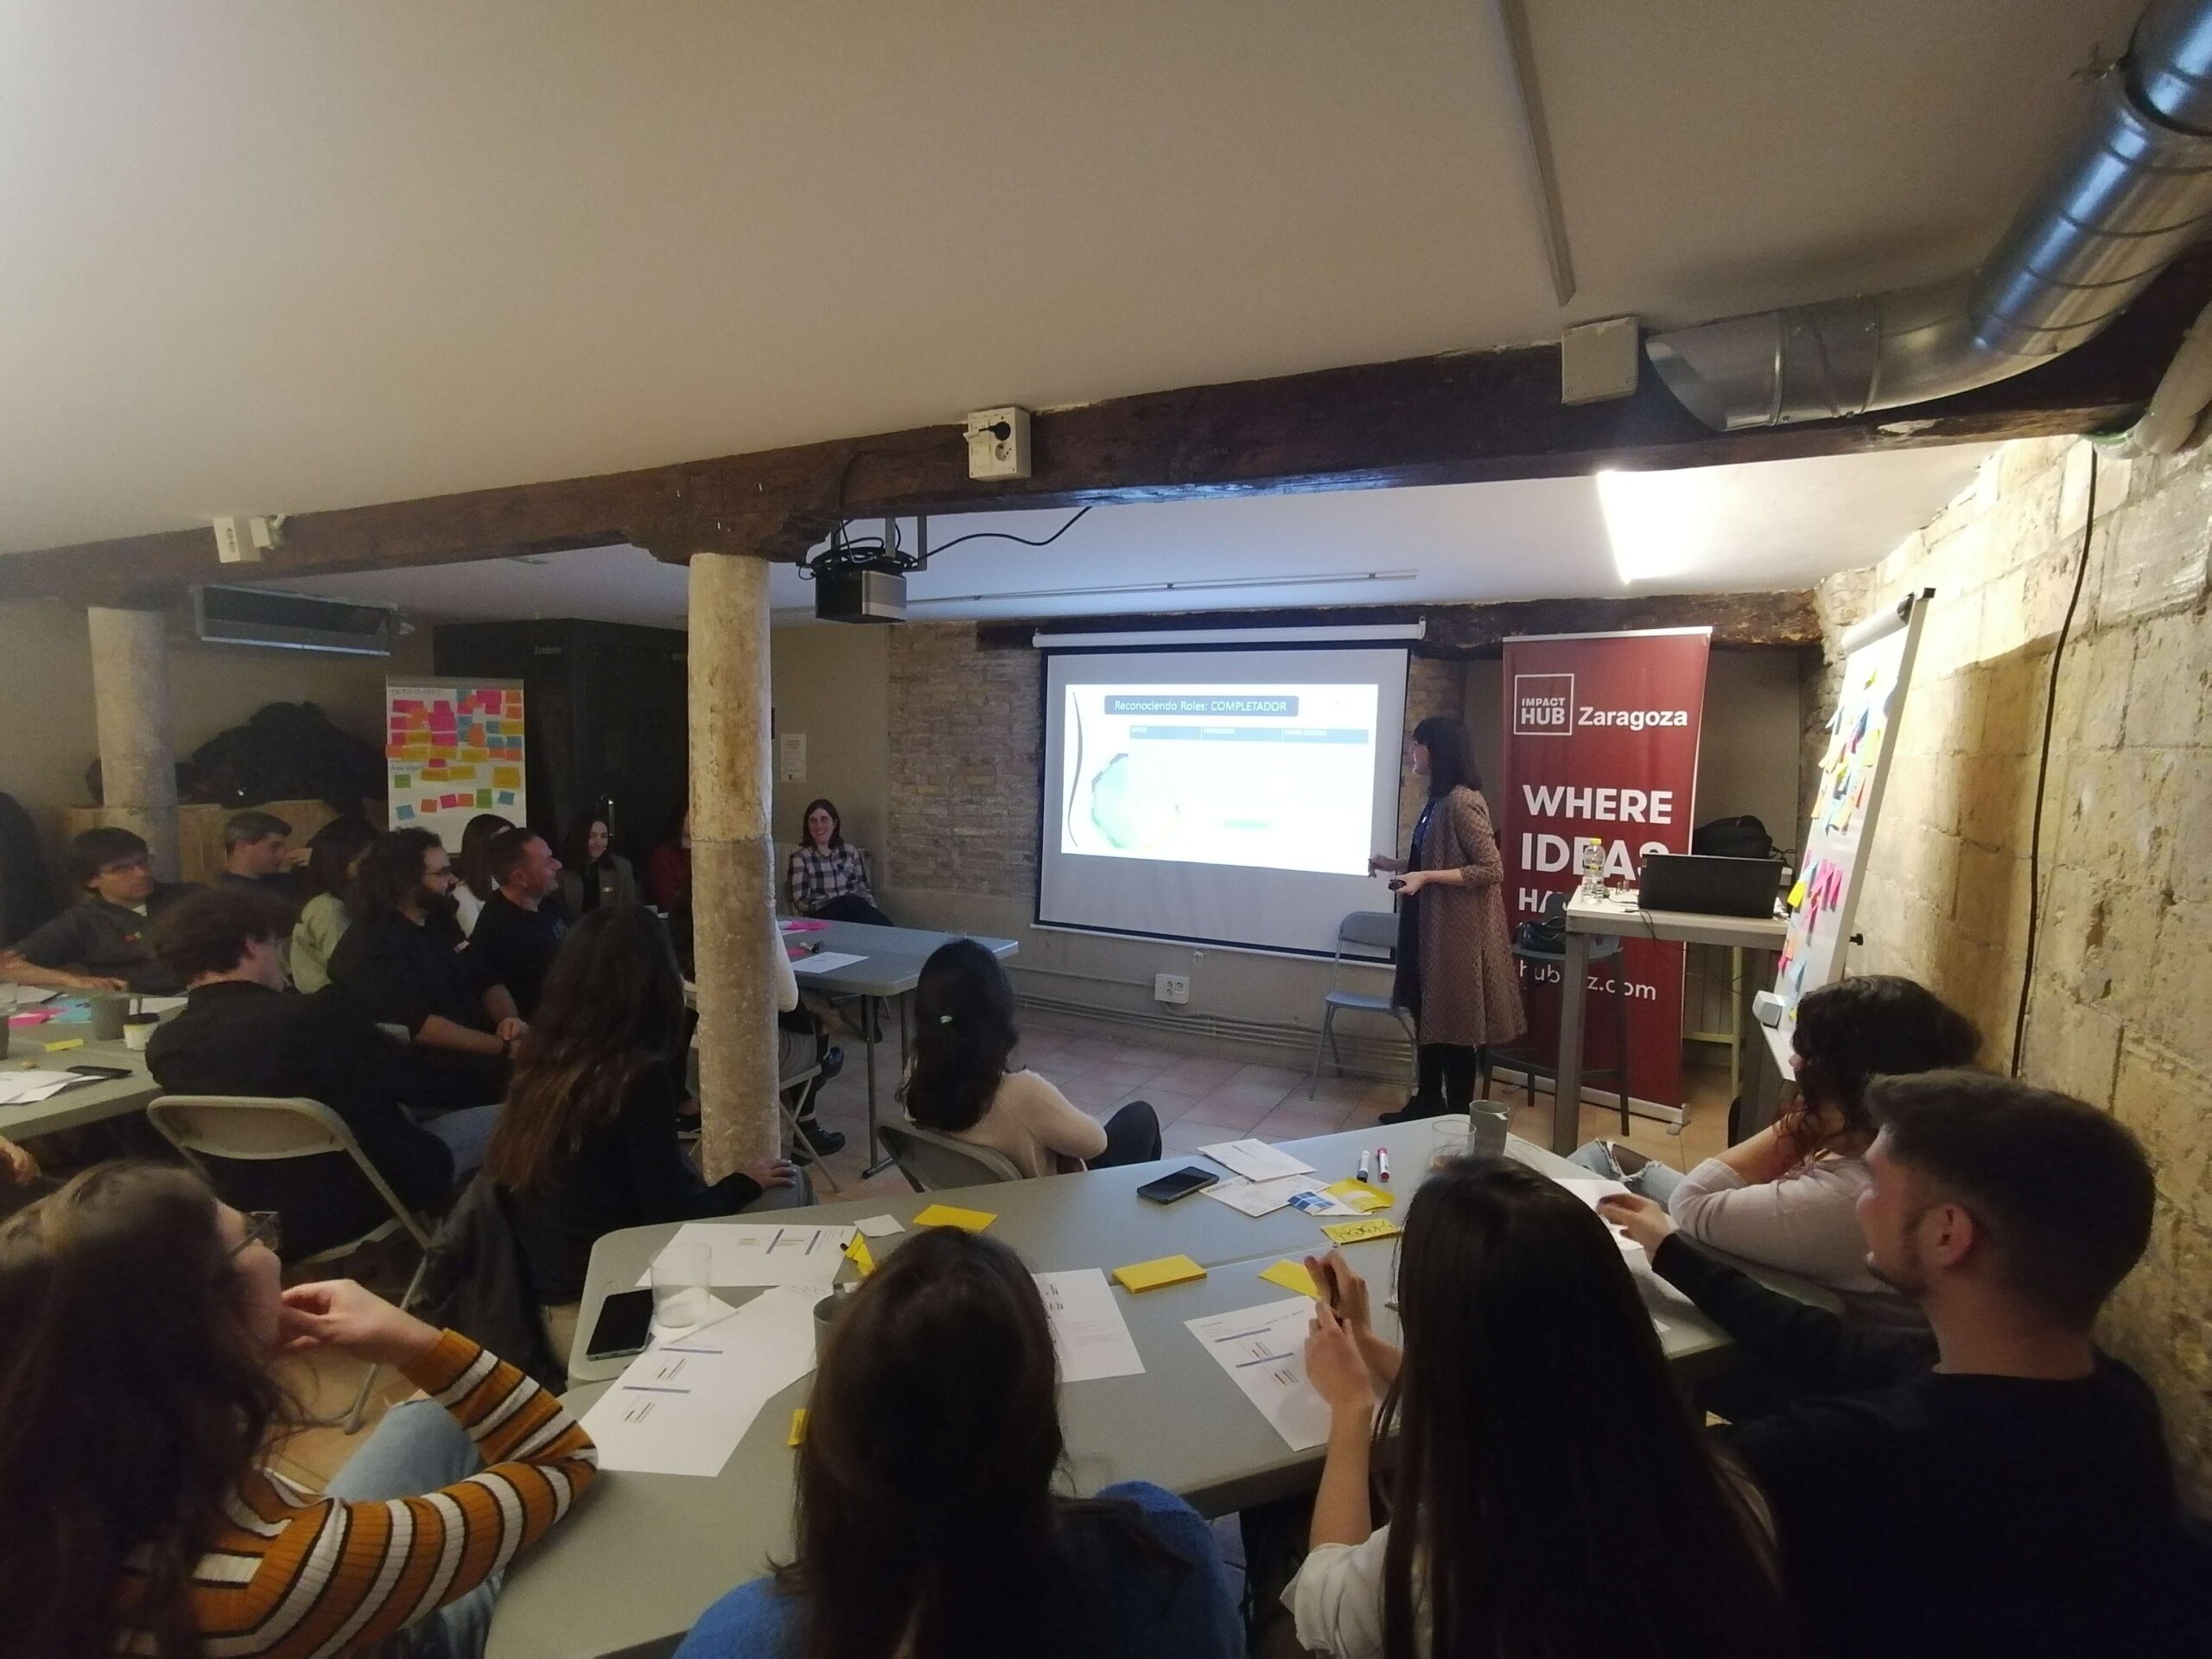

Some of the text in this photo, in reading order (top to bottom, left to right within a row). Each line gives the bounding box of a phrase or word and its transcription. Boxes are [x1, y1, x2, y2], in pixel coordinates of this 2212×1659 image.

[1114, 701, 1287, 712] Reconociendo Roles: COMPLETADOR
[1522, 697, 1565, 707] IMPACT
[1521, 707, 1565, 725] HUB
[1578, 707, 1688, 730] Zaragoza
[1522, 785, 1673, 824] WHERE
